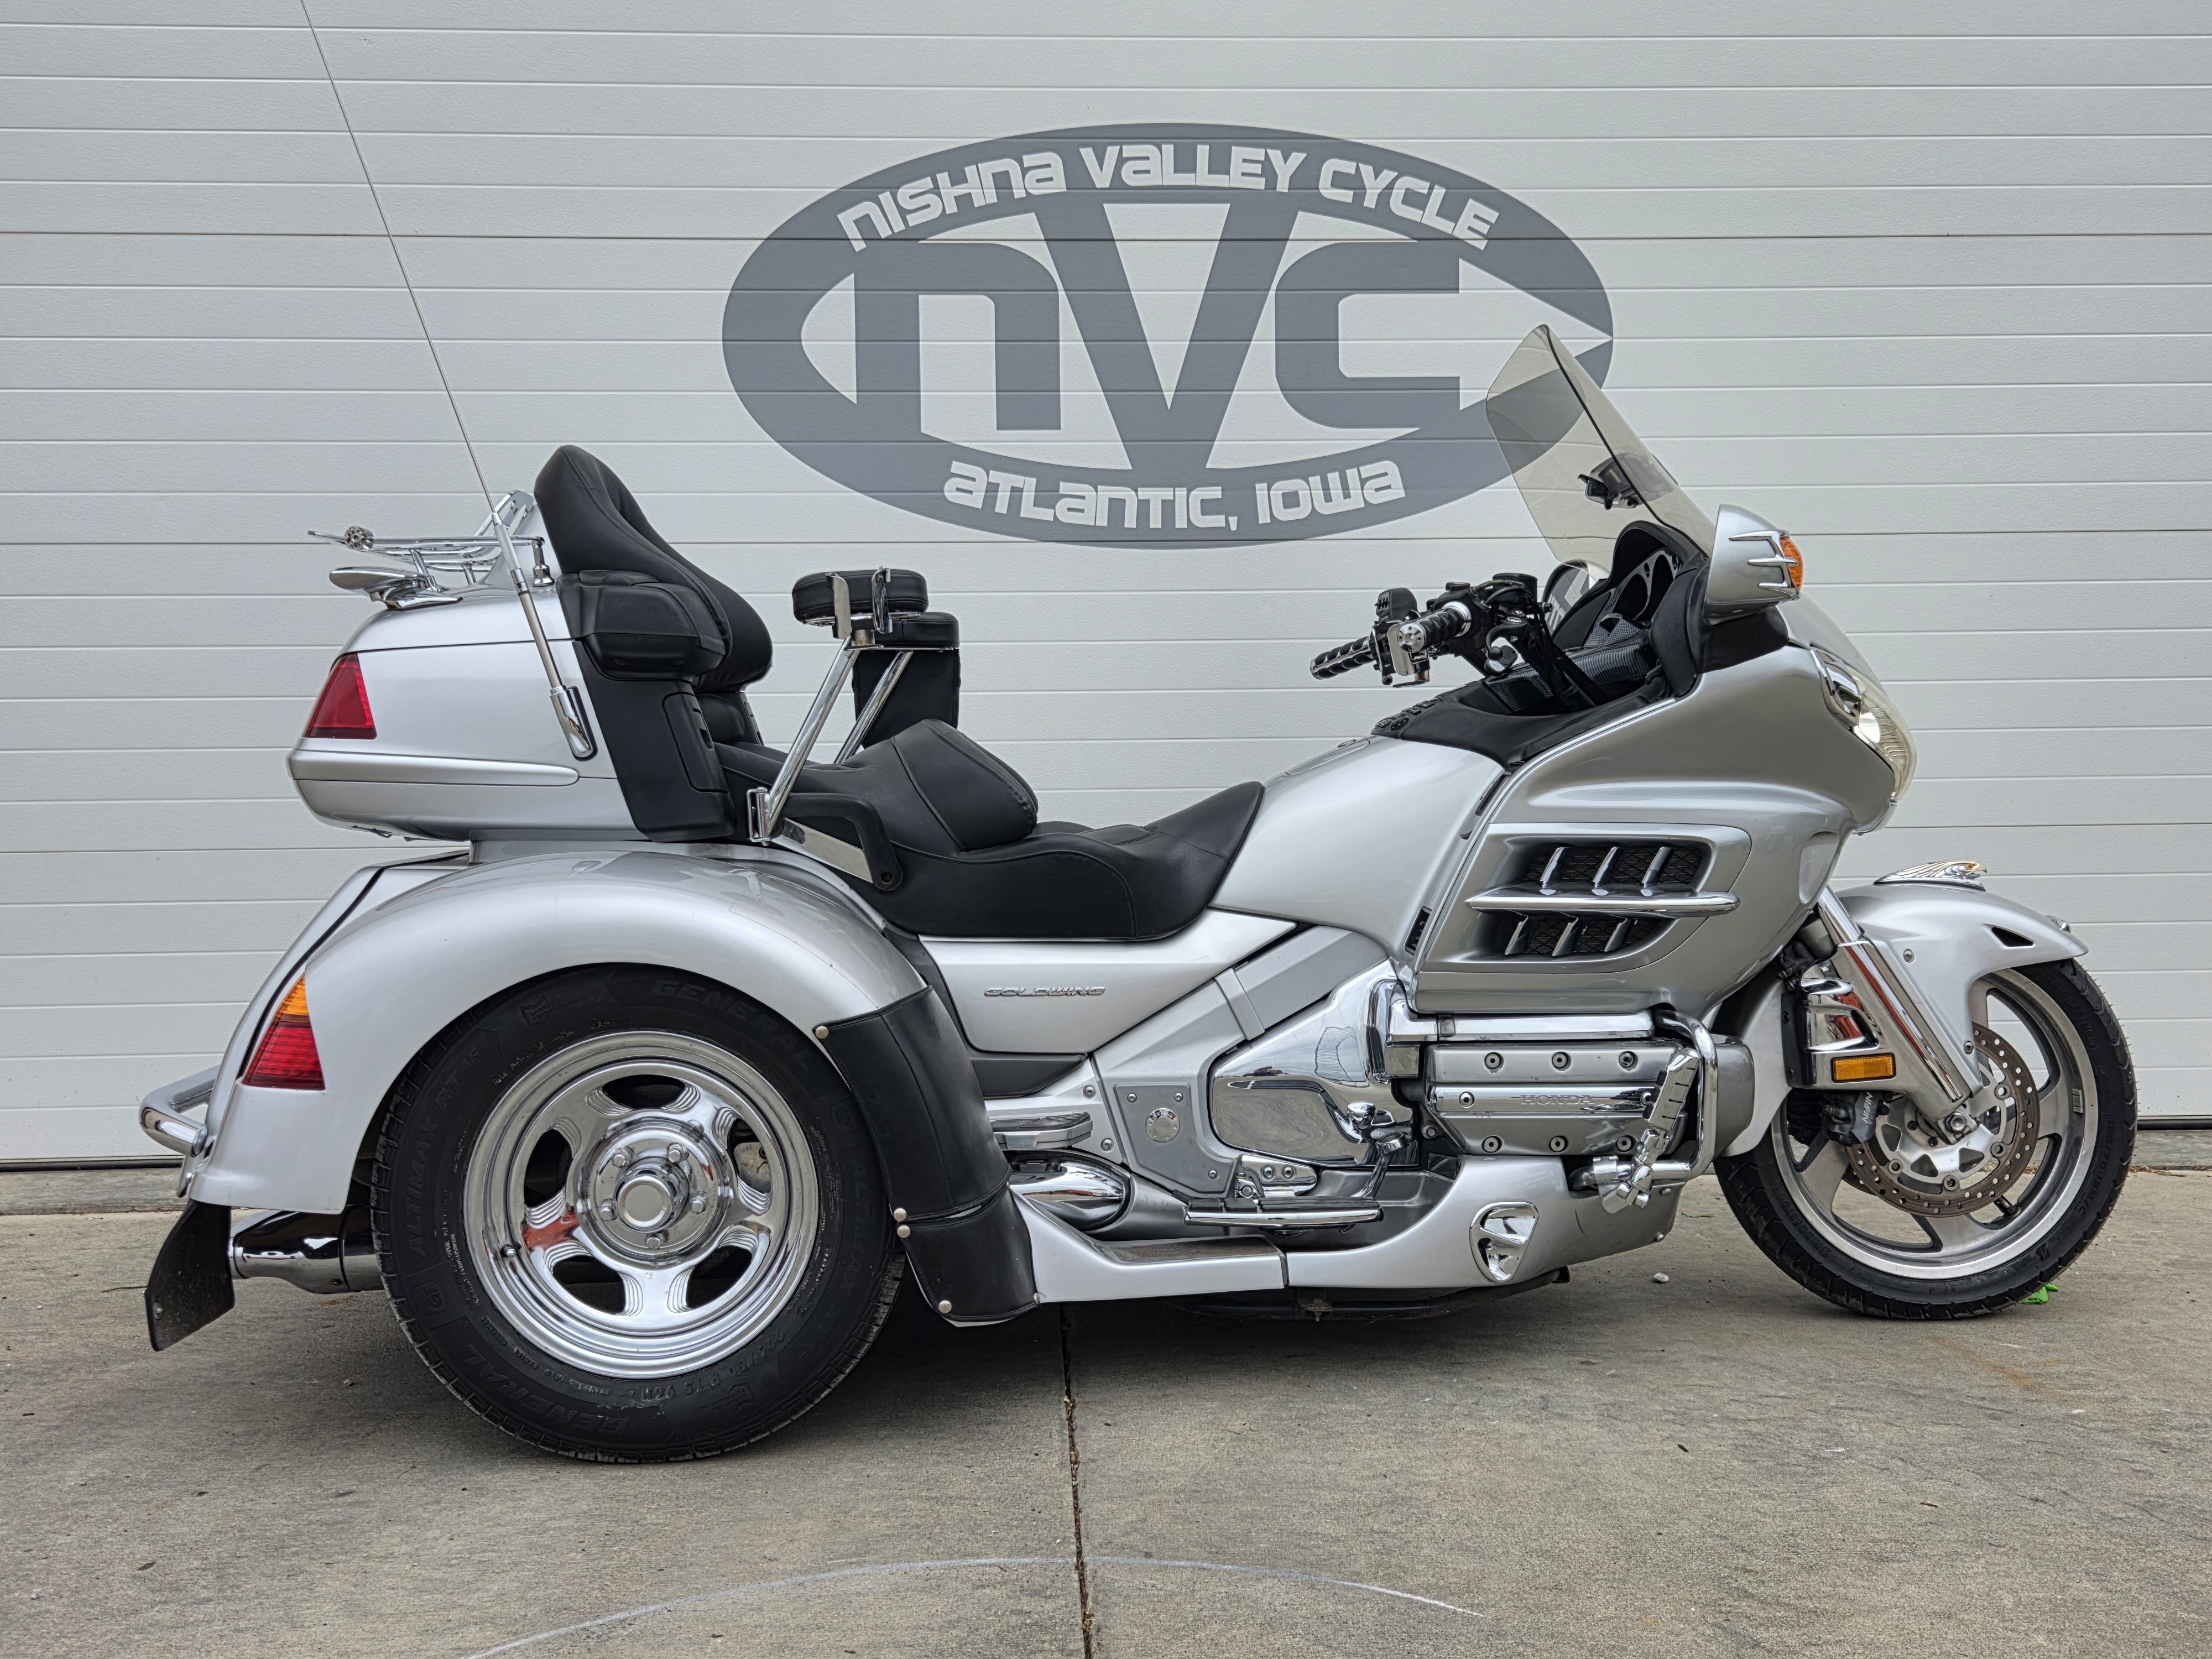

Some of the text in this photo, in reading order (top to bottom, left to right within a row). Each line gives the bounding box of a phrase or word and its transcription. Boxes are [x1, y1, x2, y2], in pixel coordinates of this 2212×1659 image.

[1319, 159, 1499, 251] CYCLE
[984, 987, 1105, 997] GOLDWING
[651, 978, 818, 1073] GENERAL
[1520, 1095, 1595, 1105] HONDA
[1861, 1092, 1873, 1124] NISSIN
[456, 1343, 630, 1436] GENERAL
